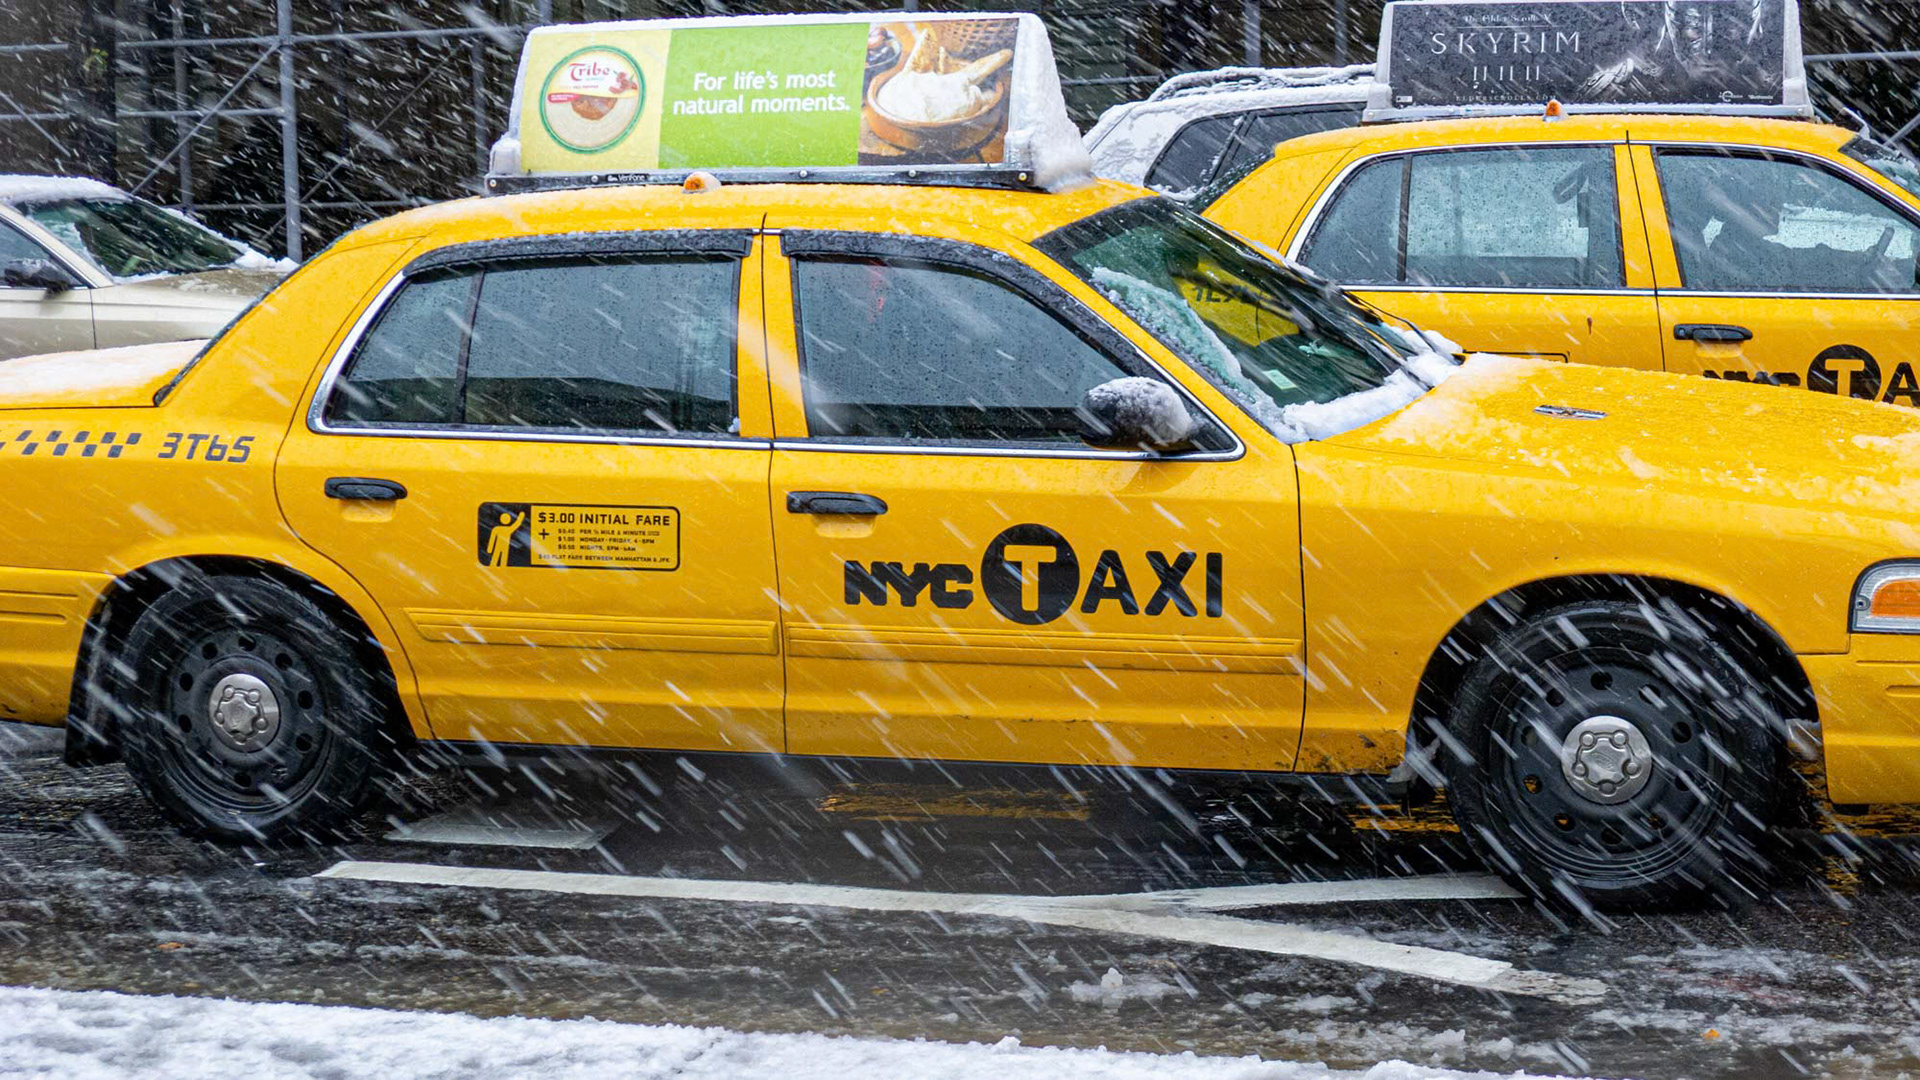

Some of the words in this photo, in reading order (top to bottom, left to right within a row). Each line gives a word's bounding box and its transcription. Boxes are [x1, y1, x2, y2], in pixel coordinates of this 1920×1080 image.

[1429, 30, 1580, 55] SKYRIM
[568, 61, 610, 82] Tribe
[693, 72, 727, 91] For
[785, 69, 837, 89] most
[672, 94, 744, 115] natural
[750, 93, 851, 113] moments.
[157, 432, 255, 463] 3T65
[538, 512, 575, 524] $3.00
[579, 513, 629, 525] INITIAL
[636, 514, 670, 526] FARE
[844, 560, 974, 610] NYC
[1004, 544, 1224, 619] TAXI
